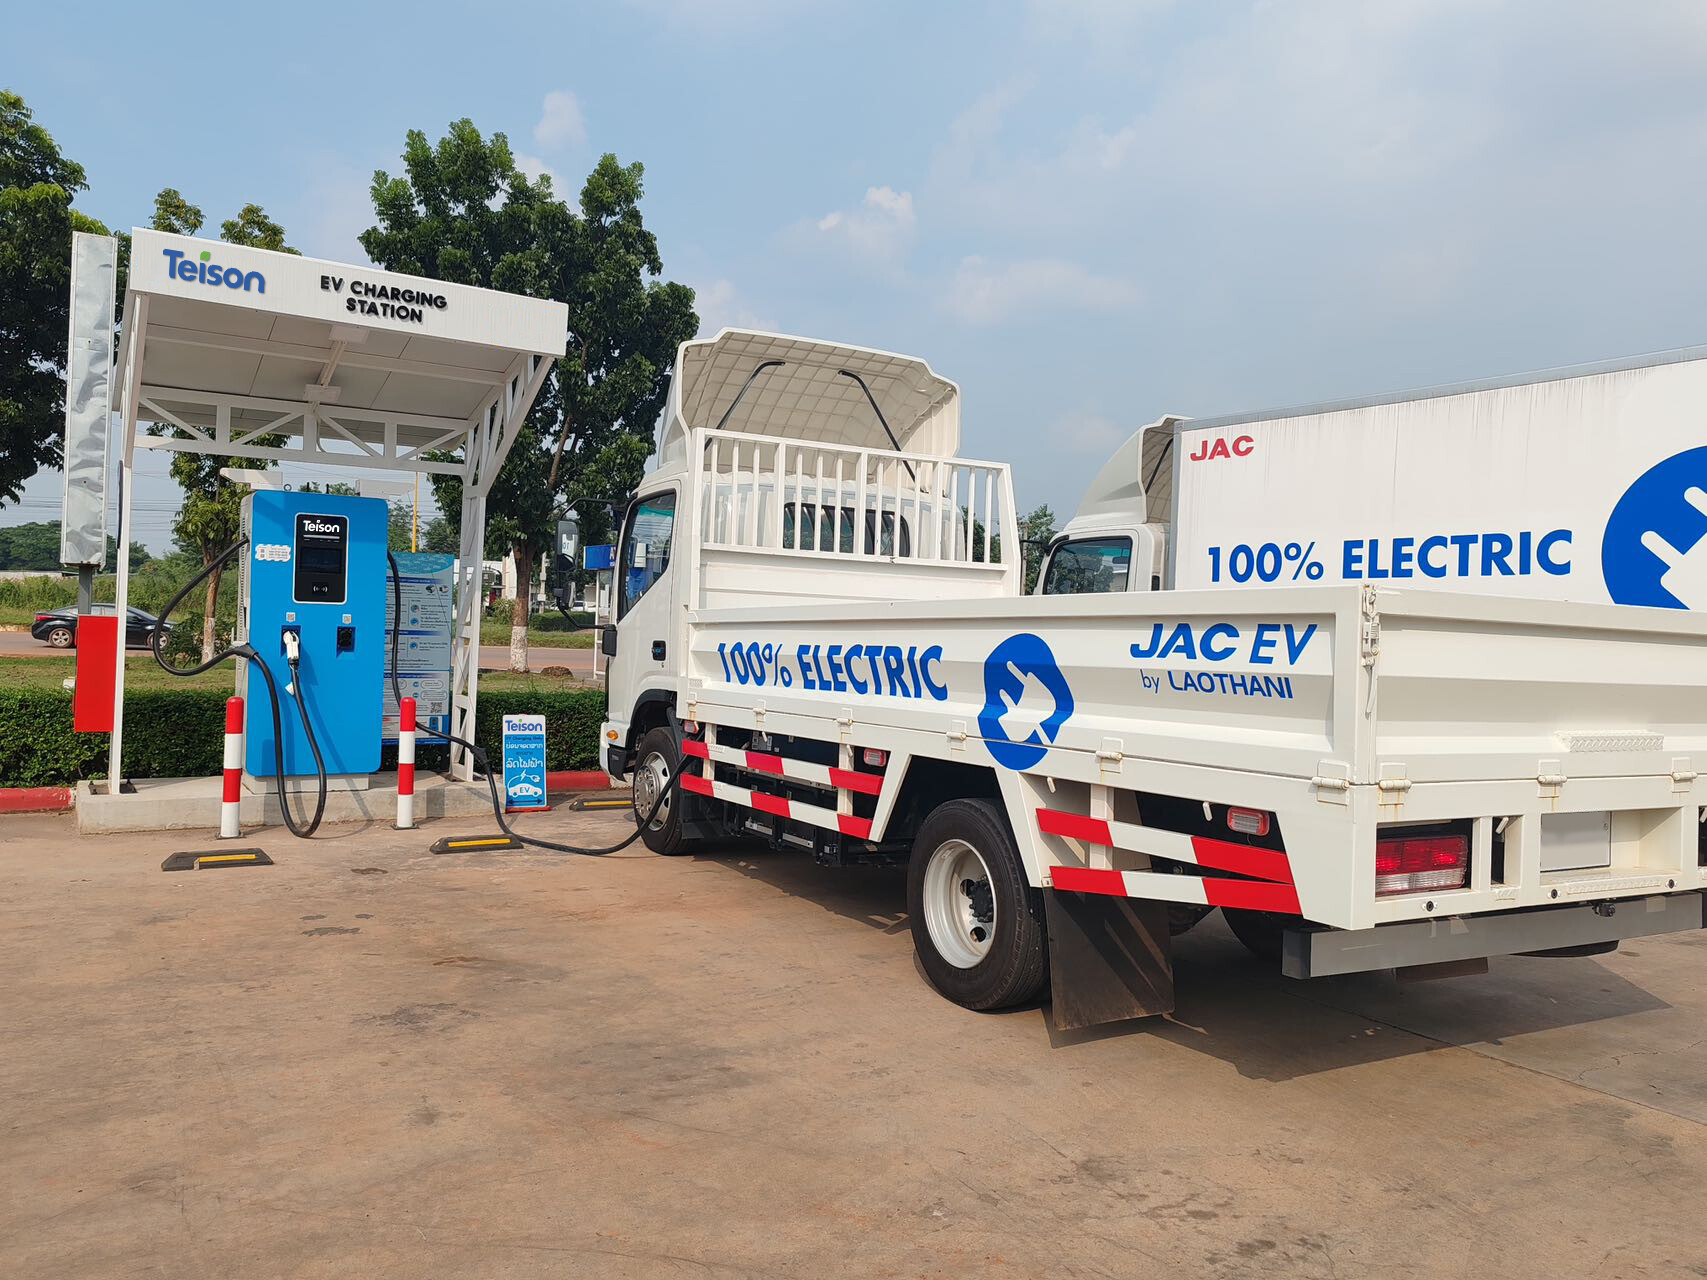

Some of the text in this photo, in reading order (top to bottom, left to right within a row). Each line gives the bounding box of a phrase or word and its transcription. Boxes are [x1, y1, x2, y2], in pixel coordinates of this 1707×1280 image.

[162, 248, 265, 294] Teison
[320, 275, 448, 310] EV CHARGING
[345, 297, 424, 323] STATION
[1189, 435, 1255, 462] JAC
[303, 519, 341, 533] Teison
[1207, 529, 1573, 584] 100% ELECTRIC
[1130, 623, 1317, 666] JAC EV
[717, 641, 949, 703] 100% ELECTRIC
[1140, 669, 1293, 698] by LAOTHANI
[505, 719, 543, 732] Teison
[519, 786, 530, 794] EV
